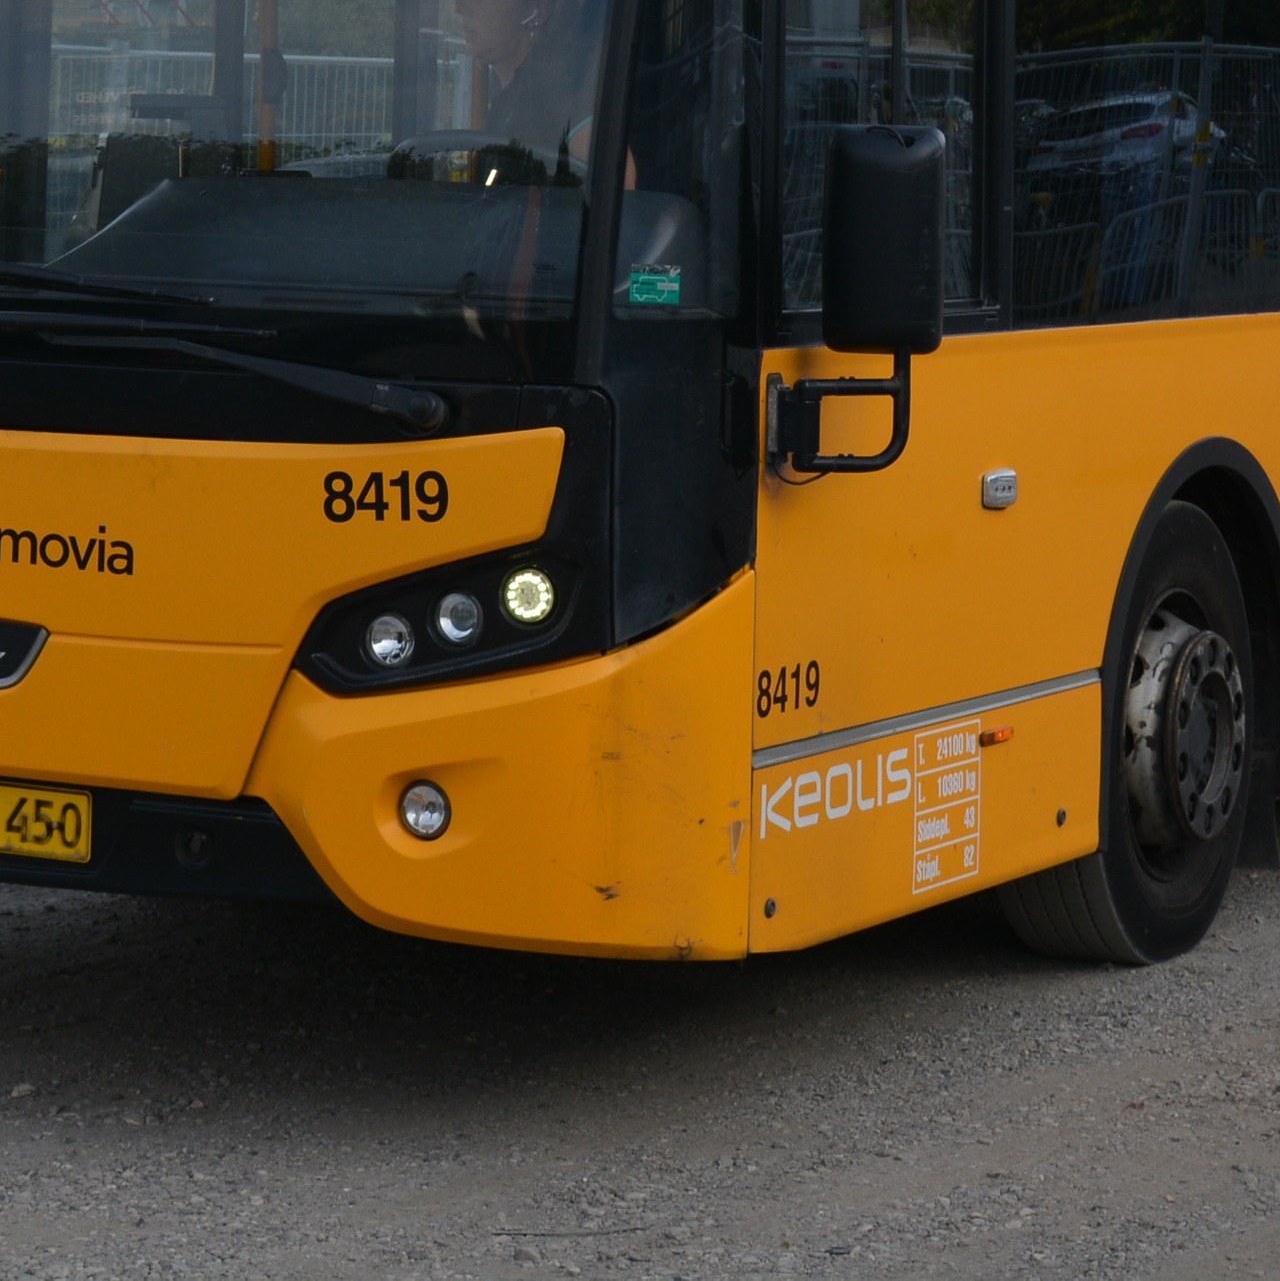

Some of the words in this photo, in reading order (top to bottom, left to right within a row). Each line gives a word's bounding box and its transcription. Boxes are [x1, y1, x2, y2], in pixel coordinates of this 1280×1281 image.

[323, 470, 449, 523] 8419
[756, 659, 821, 719] 8419
[936, 732, 964, 761] 24100
[965, 731, 977, 755] kg
[965, 769, 976, 793] kg
[5, 796, 82, 849] 450
[917, 813, 951, 844] Siddepl.
[963, 805, 976, 829] 43
[916, 852, 941, 883] Ståpl.
[963, 843, 975, 868] 82
